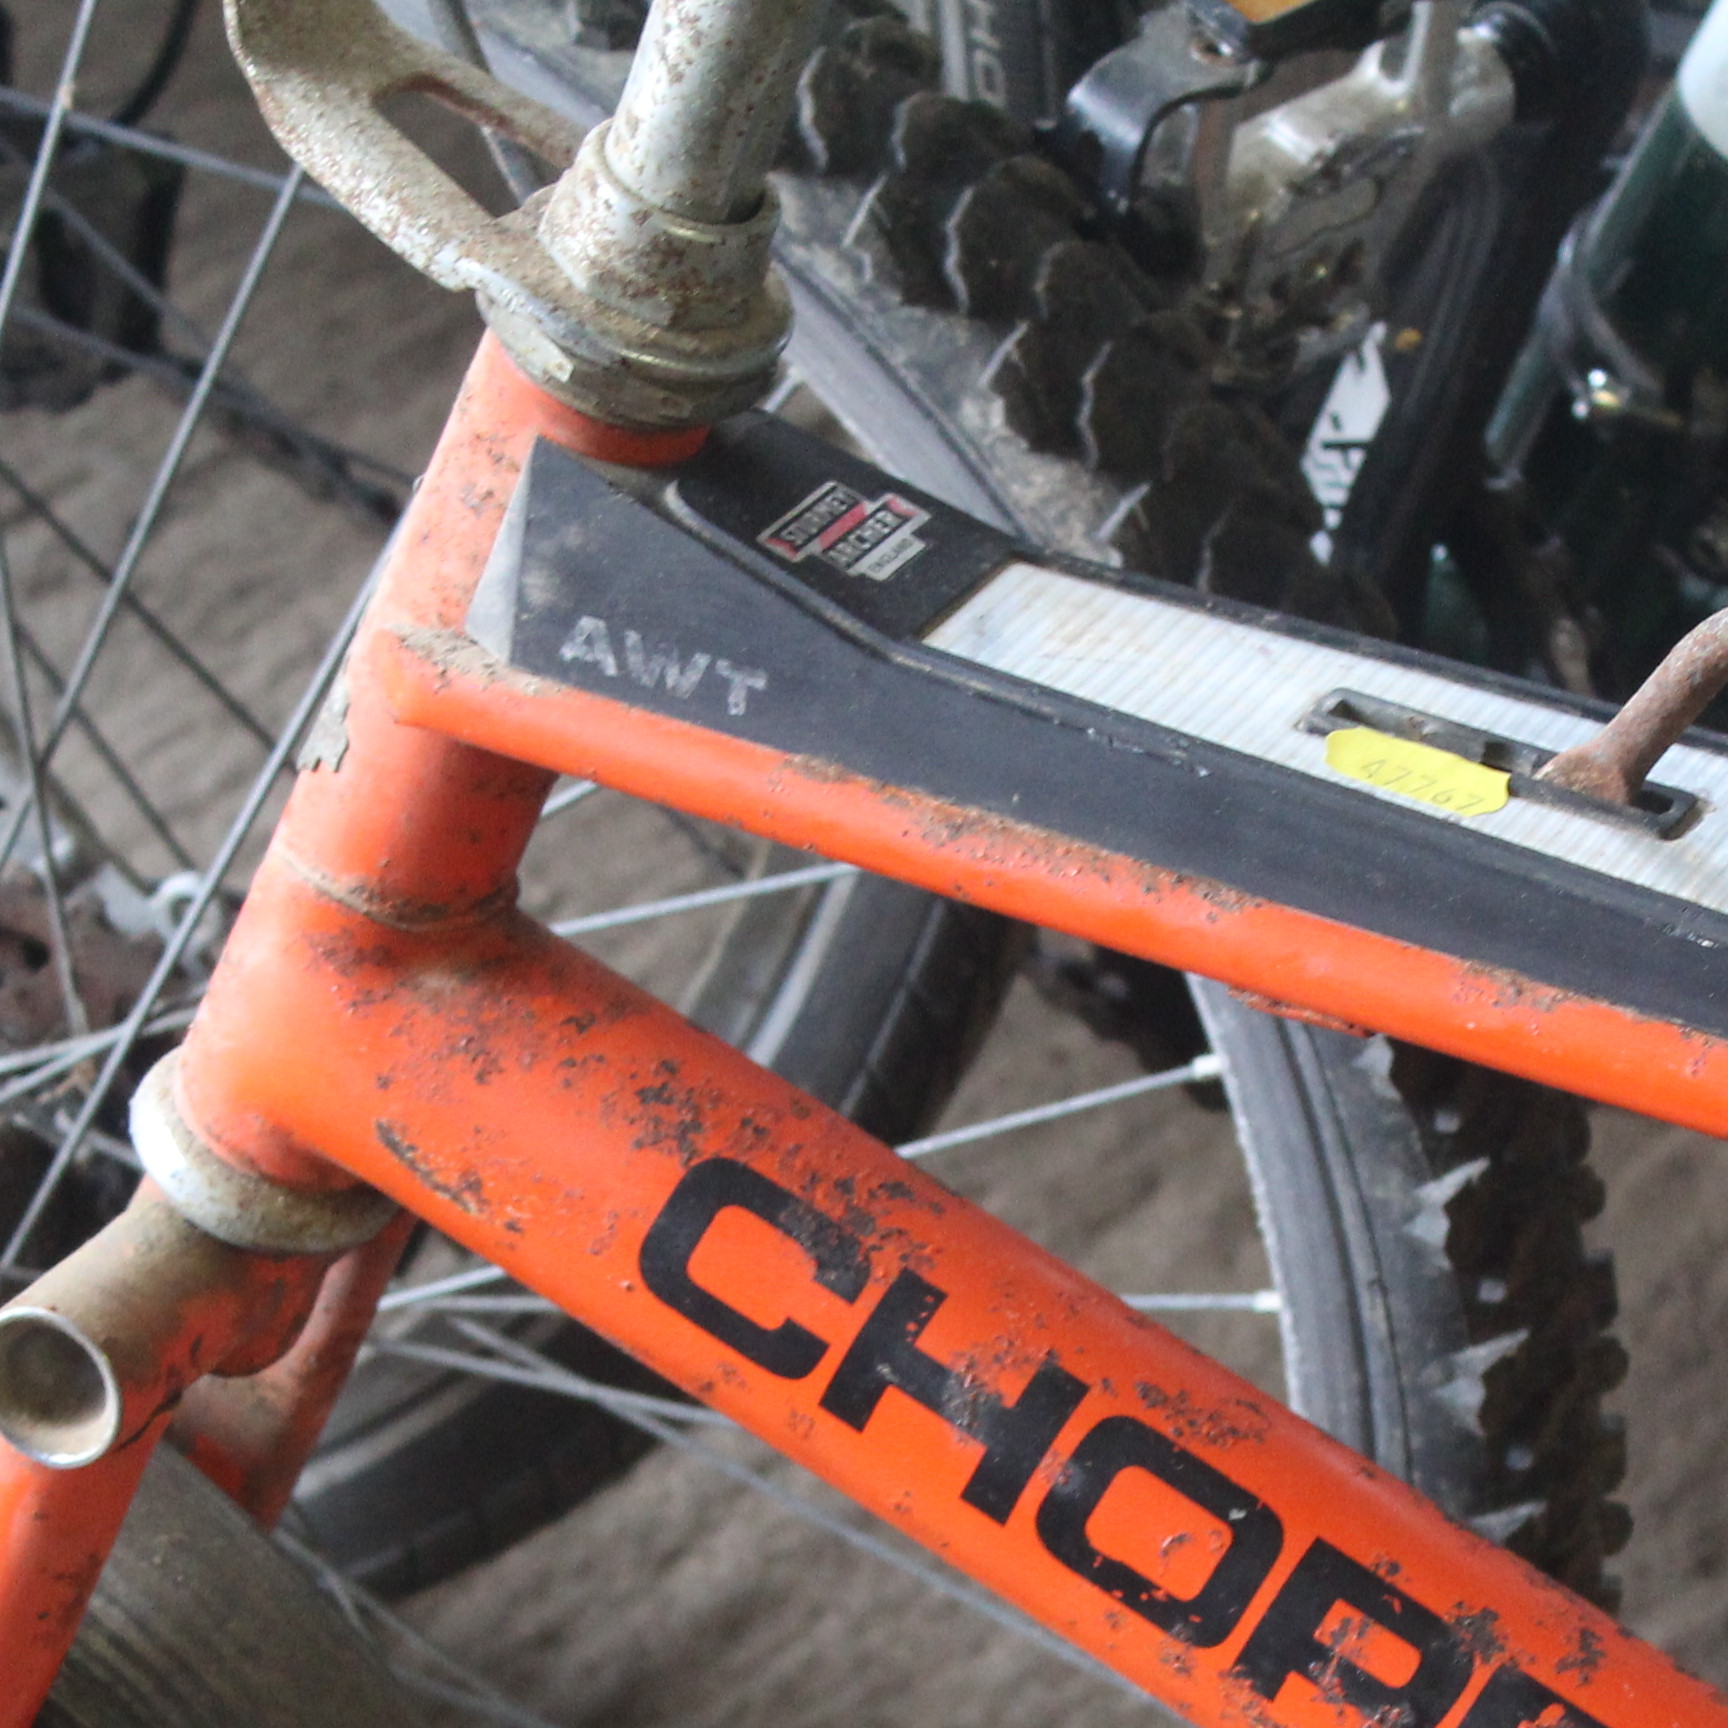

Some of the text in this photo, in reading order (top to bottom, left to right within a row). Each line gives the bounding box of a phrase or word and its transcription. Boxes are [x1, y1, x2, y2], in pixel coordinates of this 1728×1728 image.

[824, 509, 904, 569] ARCHER
[560, 615, 768, 716] AWT
[1362, 759, 1484, 811] 47767
